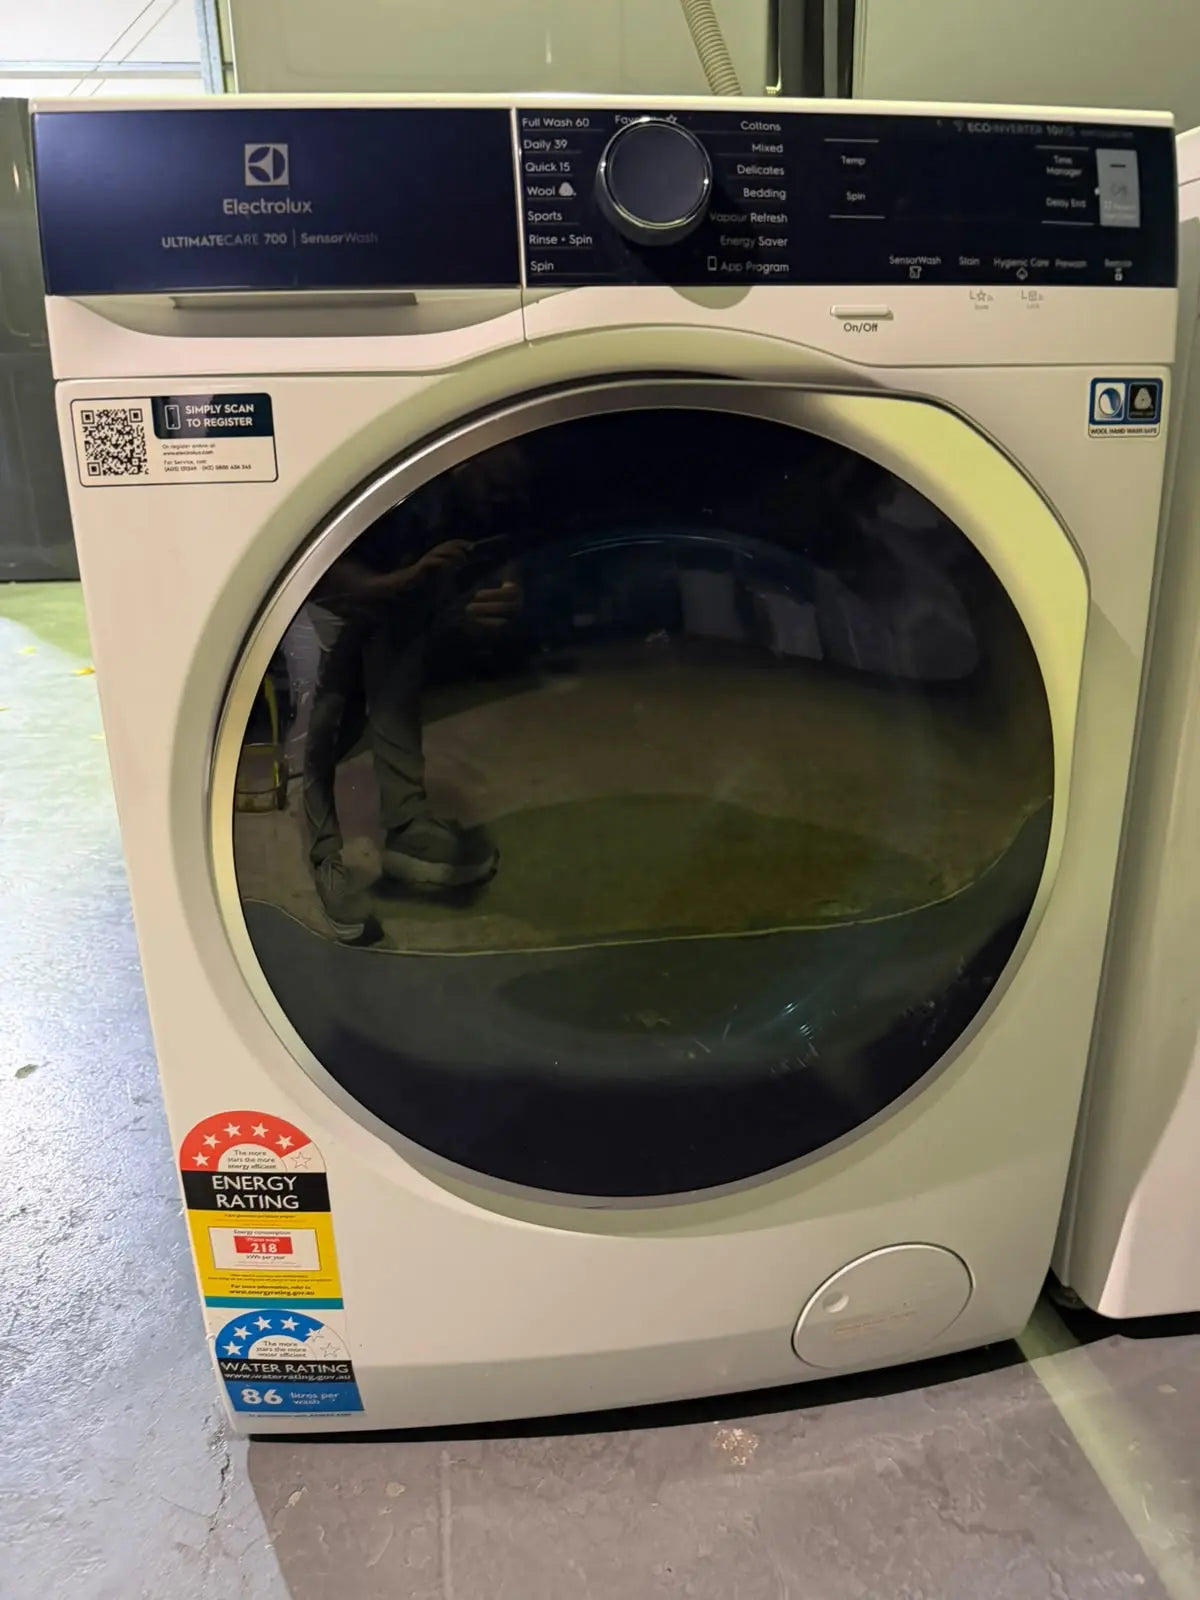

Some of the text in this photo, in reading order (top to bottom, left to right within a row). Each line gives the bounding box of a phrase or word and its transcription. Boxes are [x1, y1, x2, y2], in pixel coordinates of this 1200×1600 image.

[522, 117, 590, 128] Full Wash 60
[740, 120, 782, 132] Cottons
[523, 139, 568, 151] Daily 39
[751, 143, 784, 154] Mixed
[525, 161, 571, 172] Quick 15
[841, 155, 866, 166] Temp
[736, 164, 785, 176] Delicates
[526, 185, 556, 196] Wool
[743, 187, 787, 201] Bedding
[846, 191, 866, 202] Spin
[222, 197, 313, 215] Electrolux
[527, 210, 563, 222] Sports
[750, 212, 788, 224] Refresh
[161, 231, 379, 248] ULTIMATECARE 700 SensorWash
[528, 234, 558, 245] Rinse
[568, 234, 593, 246] Spin
[719, 235, 788, 248] Energy Saver
[530, 260, 555, 273] Spin
[889, 255, 942, 266] SensorWash
[958, 256, 980, 266] Stain
[1030, 257, 1049, 267] Care
[720, 261, 790, 274] App Program
[843, 322, 878, 333] On/Off
[184, 403, 255, 415] SIMPLY SCAN
[186, 417, 253, 428] TO REGISTER
[212, 1175, 297, 1191] ENERGY
[215, 1194, 300, 1210] RATING
[250, 1242, 278, 1254] 218
[220, 1361, 349, 1374] WATER RATING
[224, 1372, 352, 1381] www.waterrating.gov.au
[240, 1388, 284, 1405] 86
[320, 1391, 340, 1400] per
